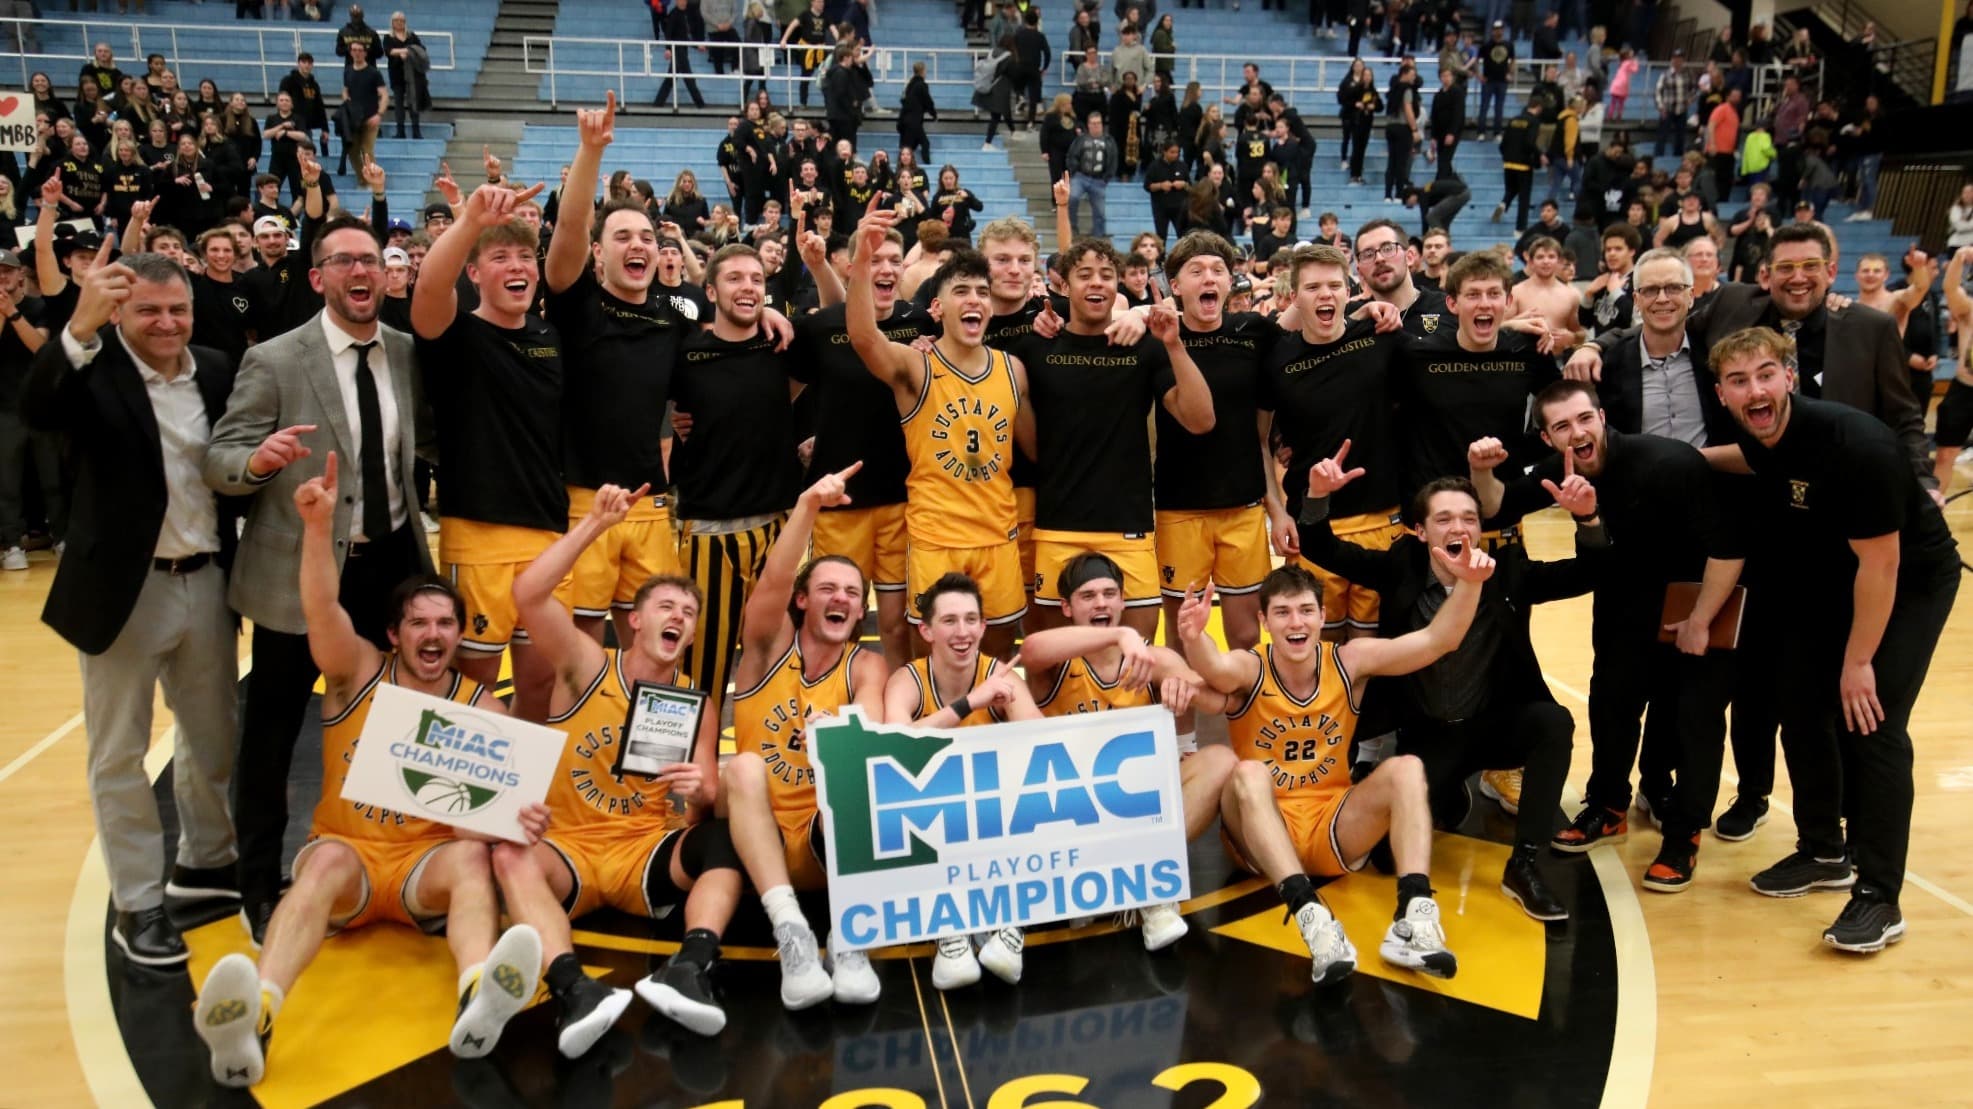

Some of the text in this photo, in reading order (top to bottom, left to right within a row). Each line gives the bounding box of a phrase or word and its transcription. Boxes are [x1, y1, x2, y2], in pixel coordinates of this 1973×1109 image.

[1, 124, 36, 147] MBB
[1249, 143, 1264, 157] 33
[1000, 323, 1034, 337] GUSTI
[1184, 336, 1215, 348] LDEN
[1046, 354, 1138, 366] GOLDEN GUSTIES
[1284, 353, 1331, 374] GOLDE
[1428, 361, 1525, 374] GOLDEN GUSTIES
[931, 397, 1008, 443] GUSTAVUS
[966, 429, 980, 454] 3
[651, 700, 687, 716] MIAC
[635, 724, 690, 738] CHAMPIONS
[644, 717, 685, 729] PLAYOFF
[1255, 713, 1343, 751] GUSTAVUS
[425, 720, 511, 763] MIAC
[1284, 739, 1316, 761] 22
[388, 741, 521, 788] CHAMPIONS
[761, 742, 816, 786] ADOLPH
[571, 769, 647, 815] ADOLPHU
[872, 730, 1163, 853] MIAC
[946, 848, 1081, 885] PLAYOFF
[840, 859, 1183, 946] CHAMPIONS
